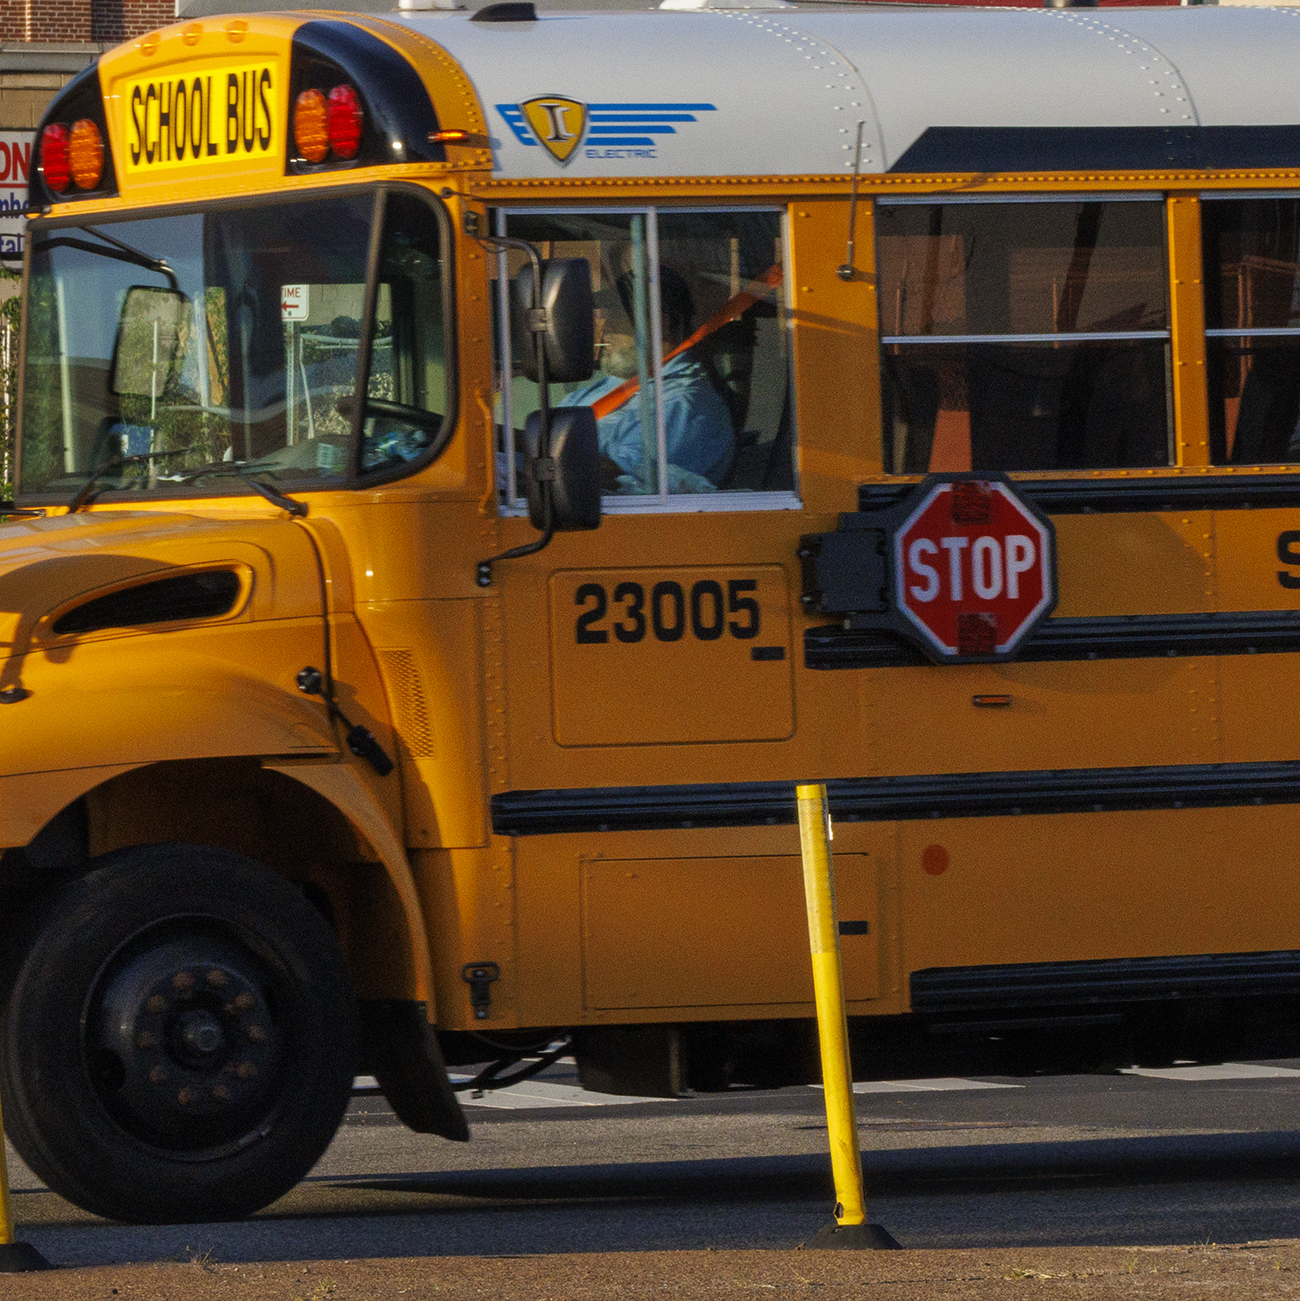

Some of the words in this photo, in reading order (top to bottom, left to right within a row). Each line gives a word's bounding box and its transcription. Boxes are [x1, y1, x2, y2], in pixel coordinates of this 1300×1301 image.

[130, 76, 218, 167] SCHOOL
[227, 68, 272, 154] BUS
[586, 149, 658, 159] ELECTRIC
[906, 534, 1035, 603] STOP
[574, 579, 761, 645] 23005
